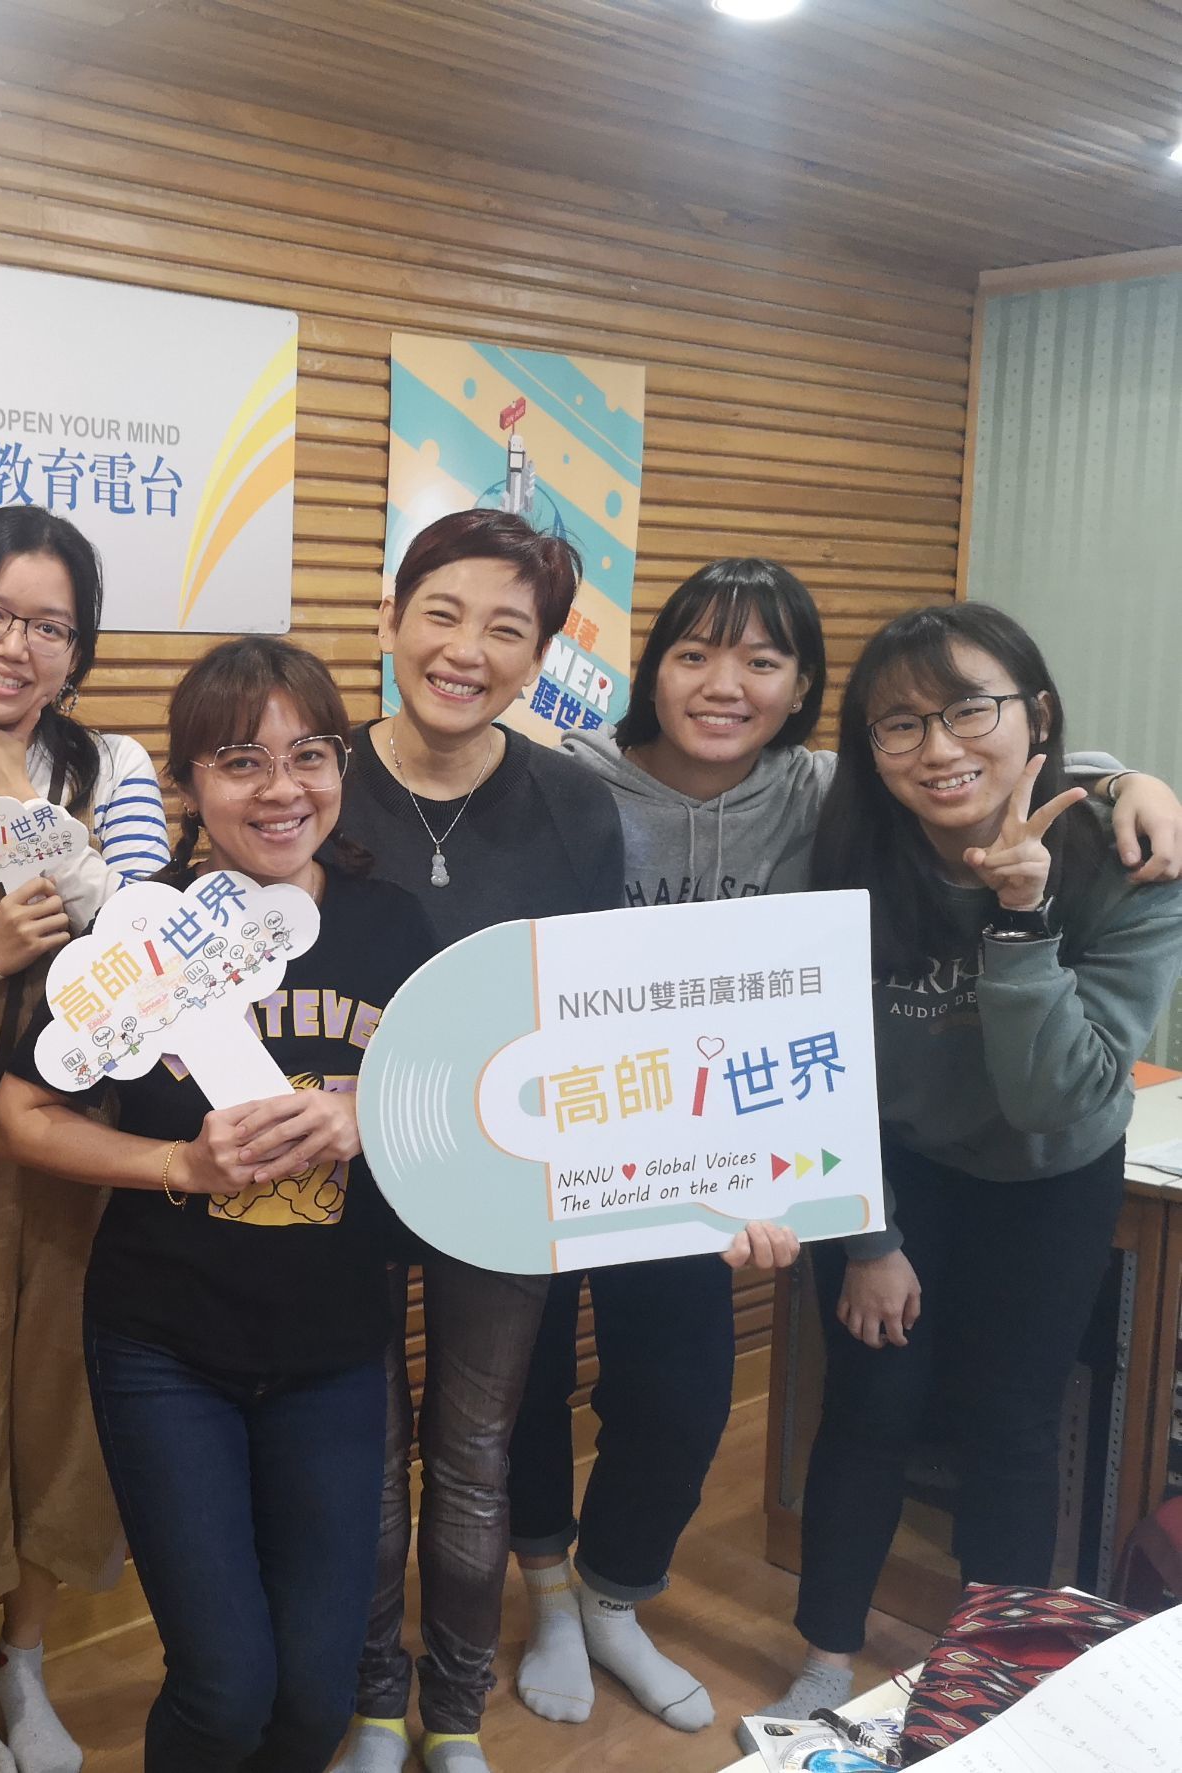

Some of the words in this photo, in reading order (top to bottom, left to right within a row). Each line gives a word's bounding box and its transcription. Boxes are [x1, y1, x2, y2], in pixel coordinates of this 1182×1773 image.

[59, 413, 121, 441] YOUR
[126, 420, 181, 447] MIND
[558, 966, 823, 1020] NKNU雙語廣播節目
[889, 1002, 948, 1019] AUDIO
[557, 1165, 614, 1189] NKNU
[645, 1154, 697, 1177] Global
[706, 1151, 757, 1170] Voices
[560, 1195, 591, 1212] The
[601, 1184, 651, 1209] World
[659, 1186, 680, 1199] on
[690, 1178, 718, 1195] the
[727, 1174, 754, 1191] Air
